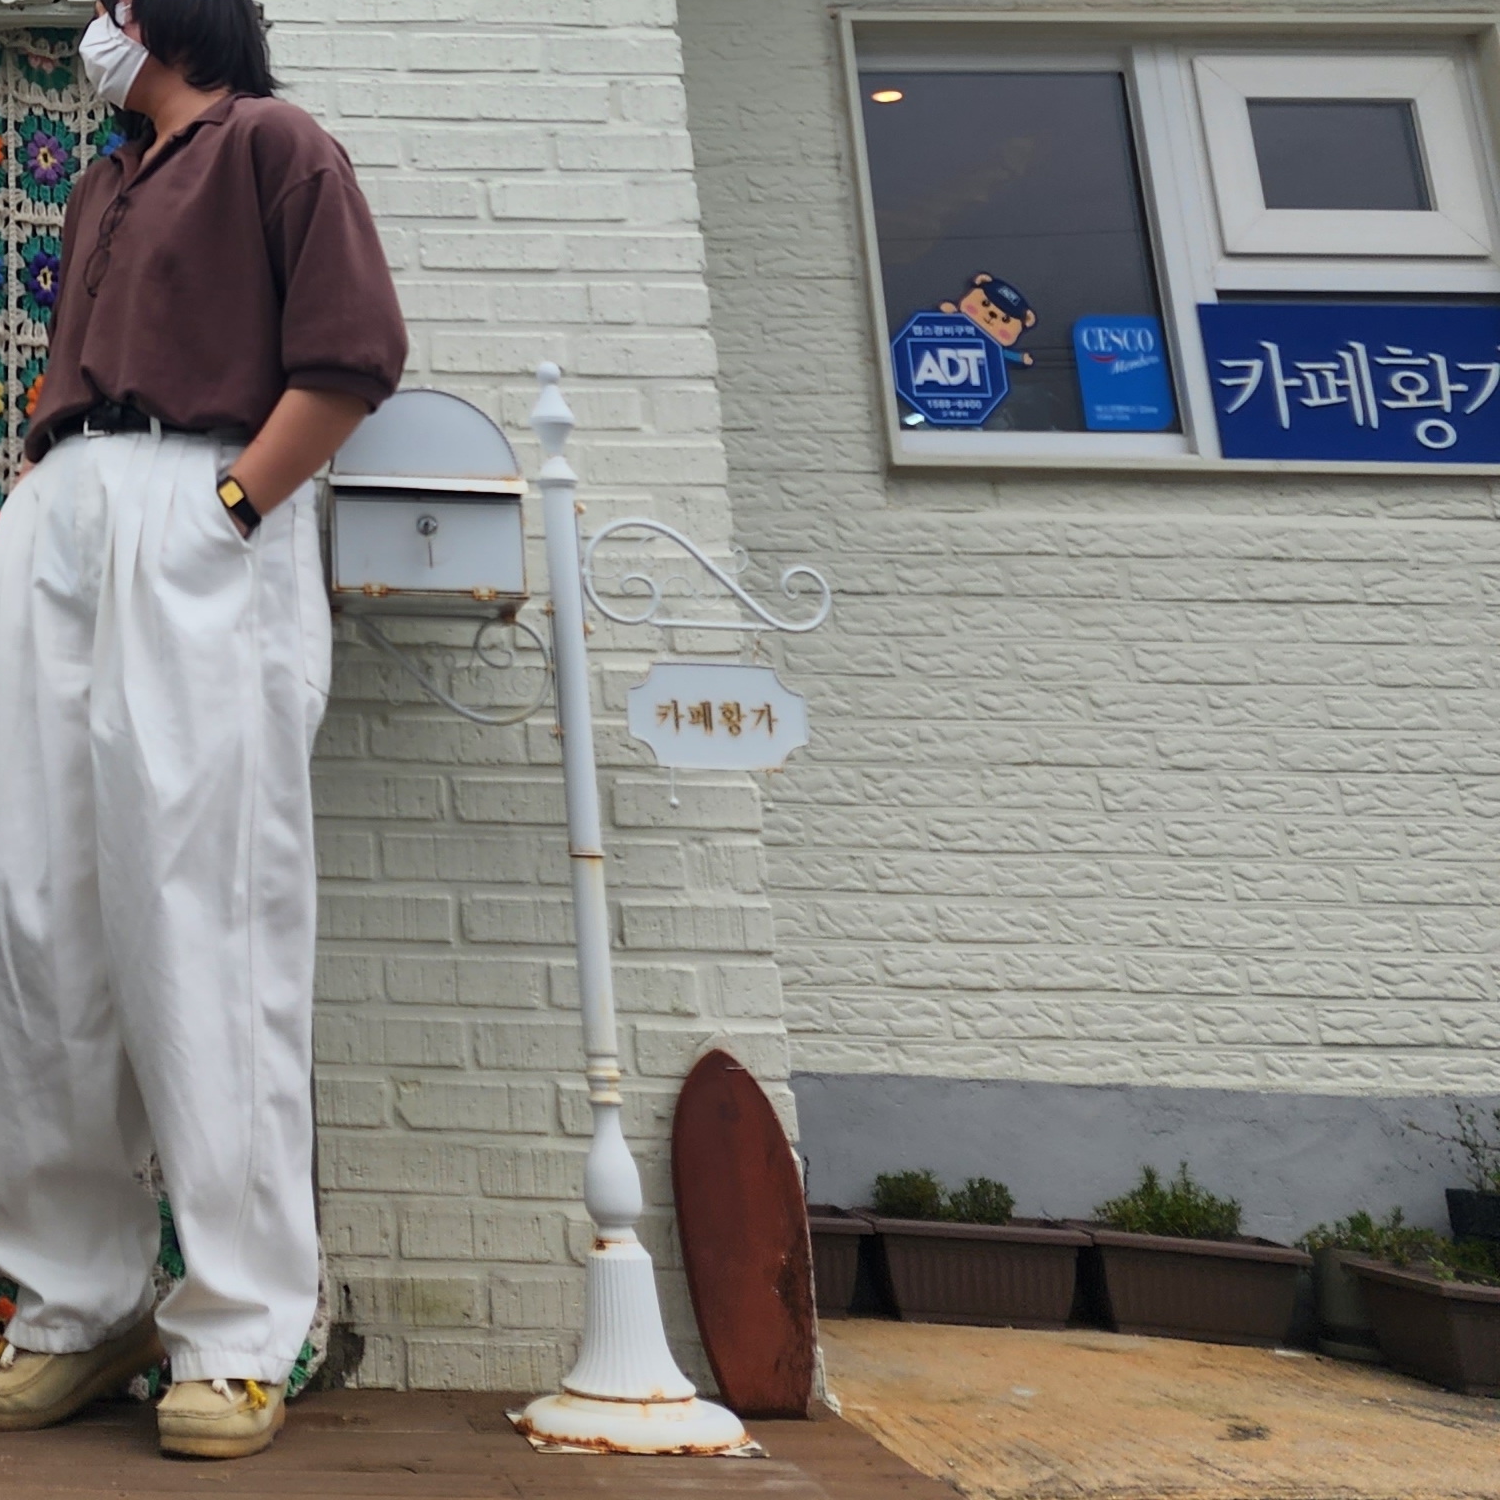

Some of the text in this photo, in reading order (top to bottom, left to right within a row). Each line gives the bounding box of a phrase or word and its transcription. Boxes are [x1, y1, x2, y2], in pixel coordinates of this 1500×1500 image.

[1082, 327, 1155, 353] CESCO
[914, 347, 985, 386] ADT
[656, 699, 778, 736] 카페황가
